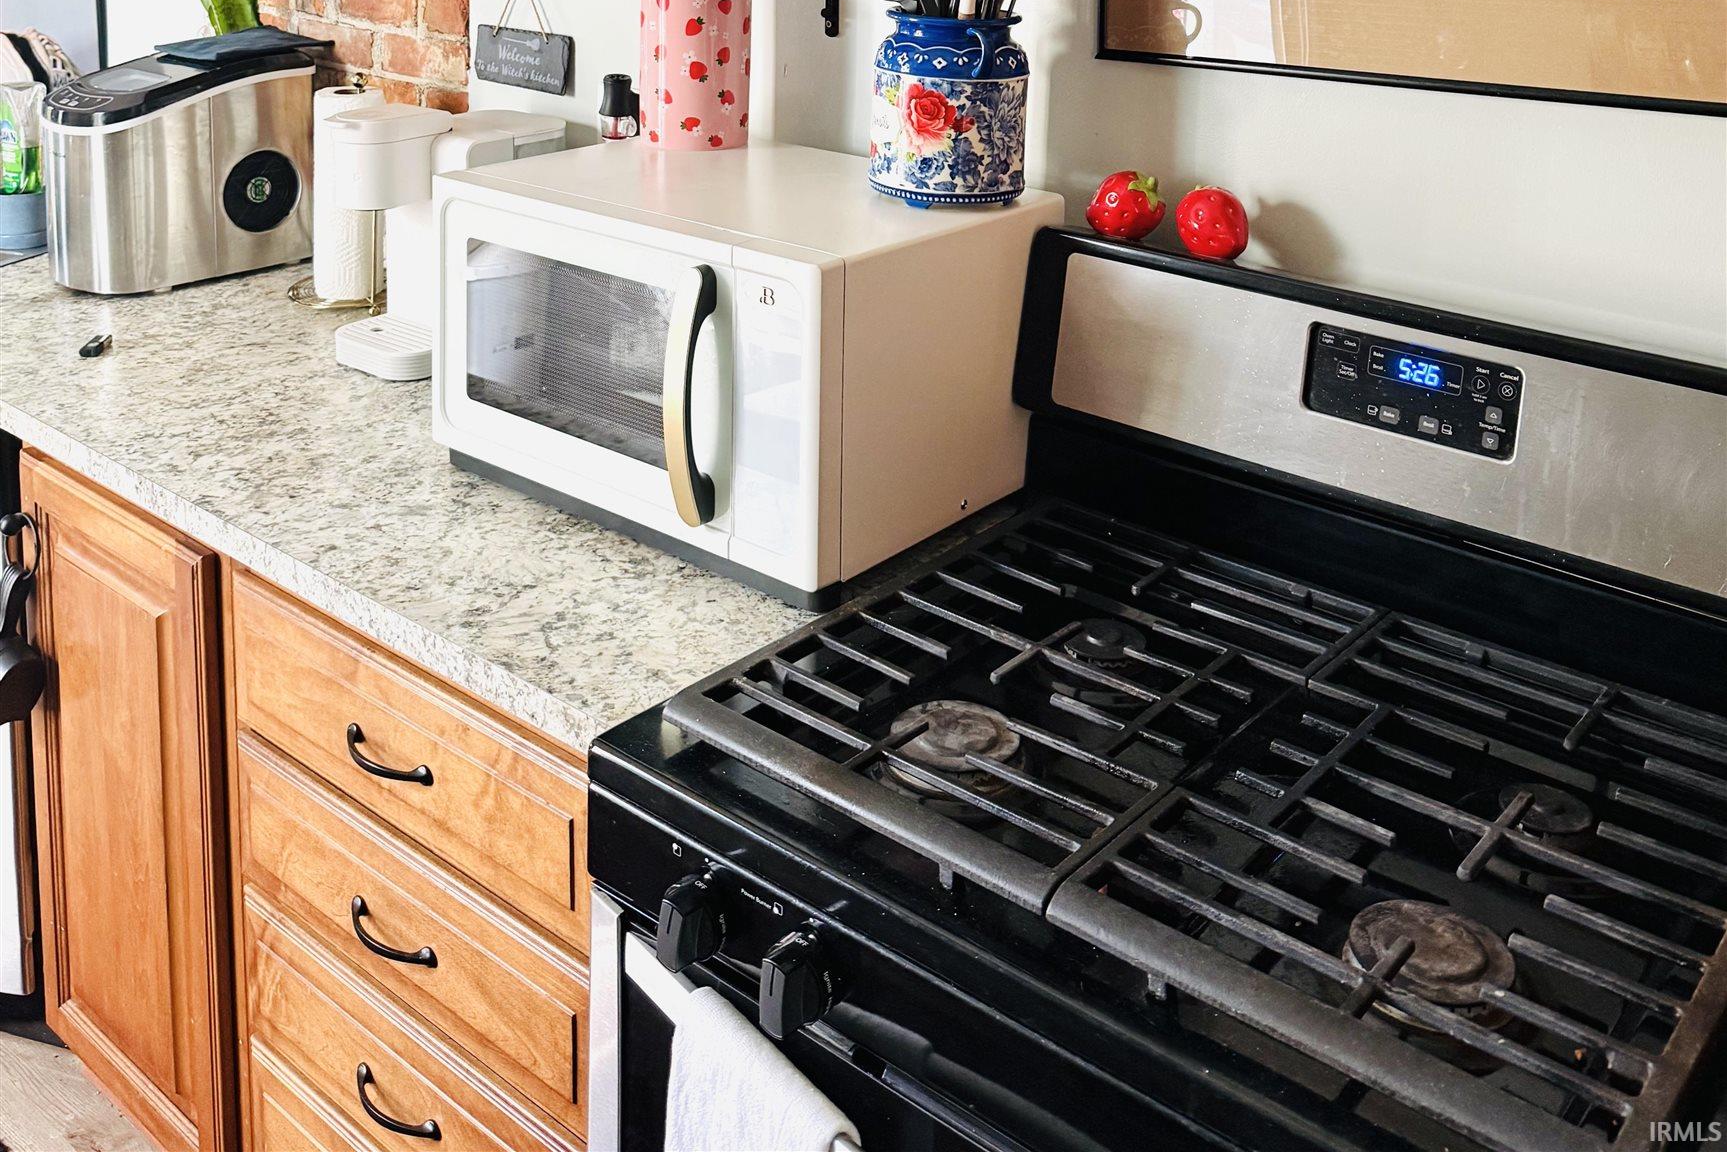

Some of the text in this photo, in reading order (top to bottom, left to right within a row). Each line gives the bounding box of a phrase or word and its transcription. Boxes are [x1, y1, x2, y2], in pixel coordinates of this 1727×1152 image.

[498, 44, 541, 66] Welcome
[476, 59, 560, 87] To the Witch's kitchen
[1399, 357, 1440, 387] 5:26
[1475, 366, 1490, 375] Start
[1499, 371, 1520, 382] Cancel
[1446, 381, 1460, 389] Timer
[1478, 421, 1507, 434] Temp/Time
[694, 880, 708, 890] OFF
[795, 937, 809, 947] OFF
